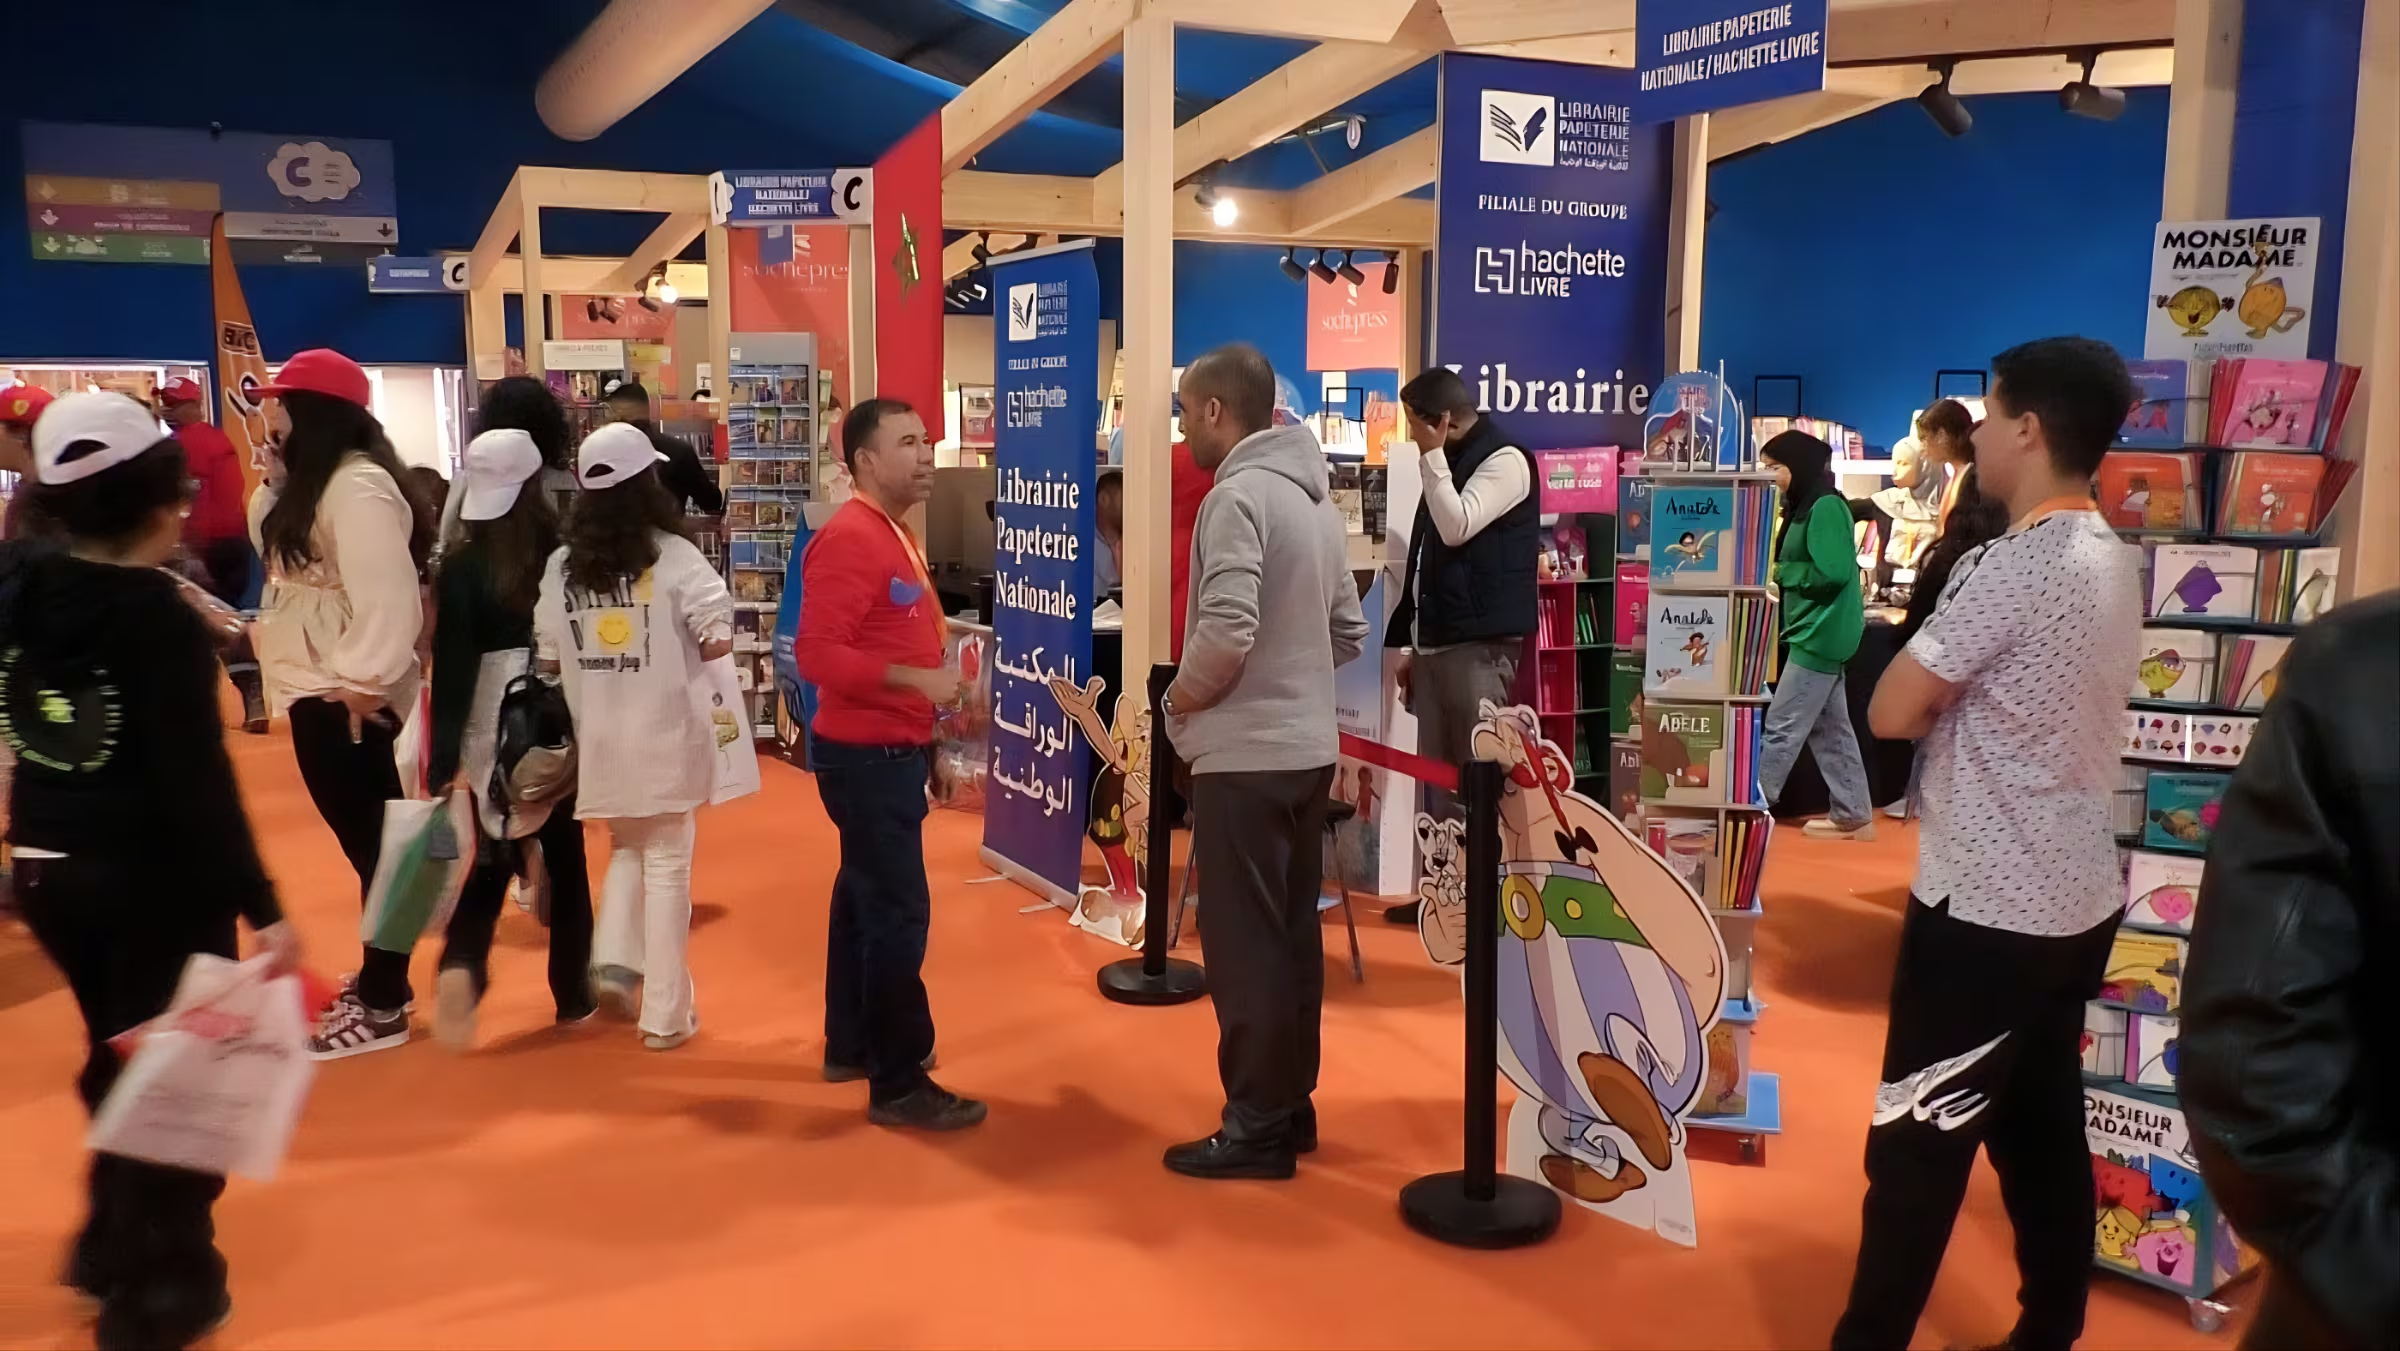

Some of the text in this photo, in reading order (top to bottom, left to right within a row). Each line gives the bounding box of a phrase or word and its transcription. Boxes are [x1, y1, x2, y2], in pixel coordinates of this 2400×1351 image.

[1663, 3, 1793, 57] LIBRAIRIE PAPETERIE
[1640, 58, 1705, 92] NATIONALE
[1713, 40, 1779, 76] HACHETTE
[1780, 30, 1820, 62] LIVRE
[1559, 101, 1630, 123] LIBRAIRIE
[1559, 119, 1630, 141] PAPETERIE
[1559, 139, 1630, 160] NATIONALE
[286, 156, 311, 187] C
[843, 176, 863, 211] C
[1478, 194, 1628, 220] FILIALE DU GROUPE
[2162, 224, 2308, 249] MONSIEUR
[451, 262, 465, 285] C
[1520, 239, 1625, 278] hachette
[2172, 249, 2297, 271] MADAME
[1520, 274, 1571, 298] LIVRE
[1024, 383, 1067, 408] hachette
[1444, 362, 1649, 416] ibrairie
[997, 467, 1080, 510] Librairie
[1666, 496, 1720, 515] Anatole
[997, 514, 1079, 565] Papeterie
[995, 569, 1077, 621] Nationale
[1660, 606, 1715, 625] Anatole
[992, 744, 1073, 818] الوطنية
[2083, 1094, 2172, 1133] ONSIEUR
[2089, 1115, 2164, 1147] ADAME
